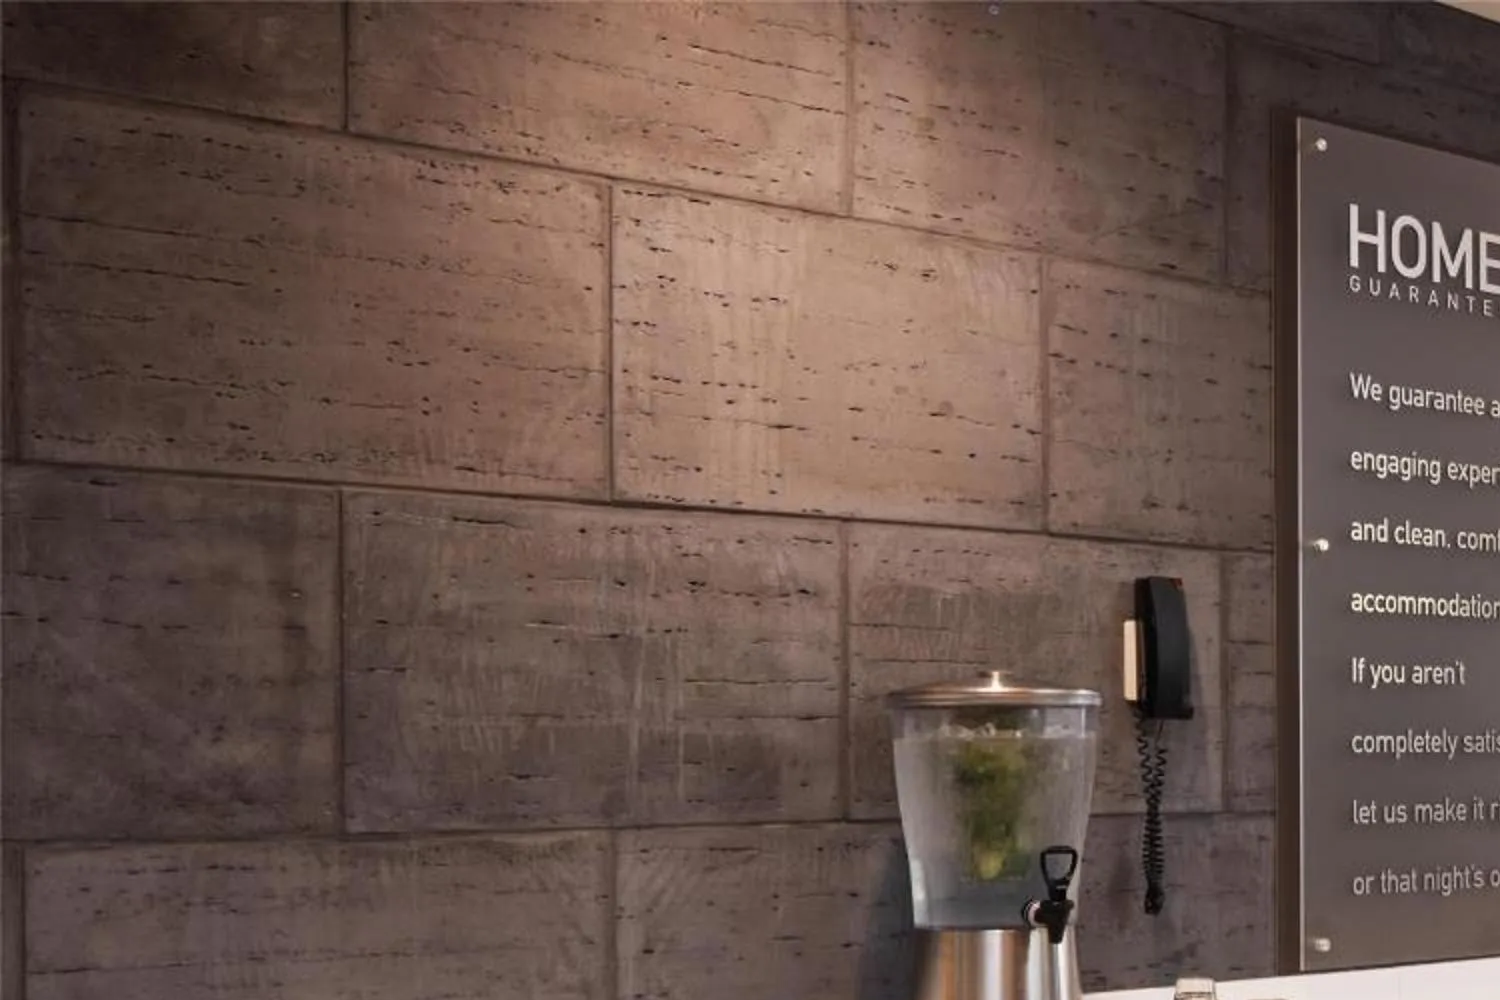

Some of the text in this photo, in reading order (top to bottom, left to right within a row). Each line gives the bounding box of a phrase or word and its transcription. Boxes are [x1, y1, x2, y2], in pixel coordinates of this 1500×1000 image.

[1350, 371, 1382, 401] We
[1389, 385, 1485, 416] guarantee
[1351, 450, 1441, 485] engaging
[1351, 517, 1389, 543] and
[1351, 656, 1366, 684] If
[1369, 662, 1406, 690] you
[1351, 727, 1460, 761] completely
[1352, 799, 1377, 825] let
[1383, 803, 1408, 824] us
[1414, 797, 1467, 823] make
[1473, 796, 1485, 820] it
[1353, 875, 1375, 896] or
[1380, 867, 1418, 894] that
